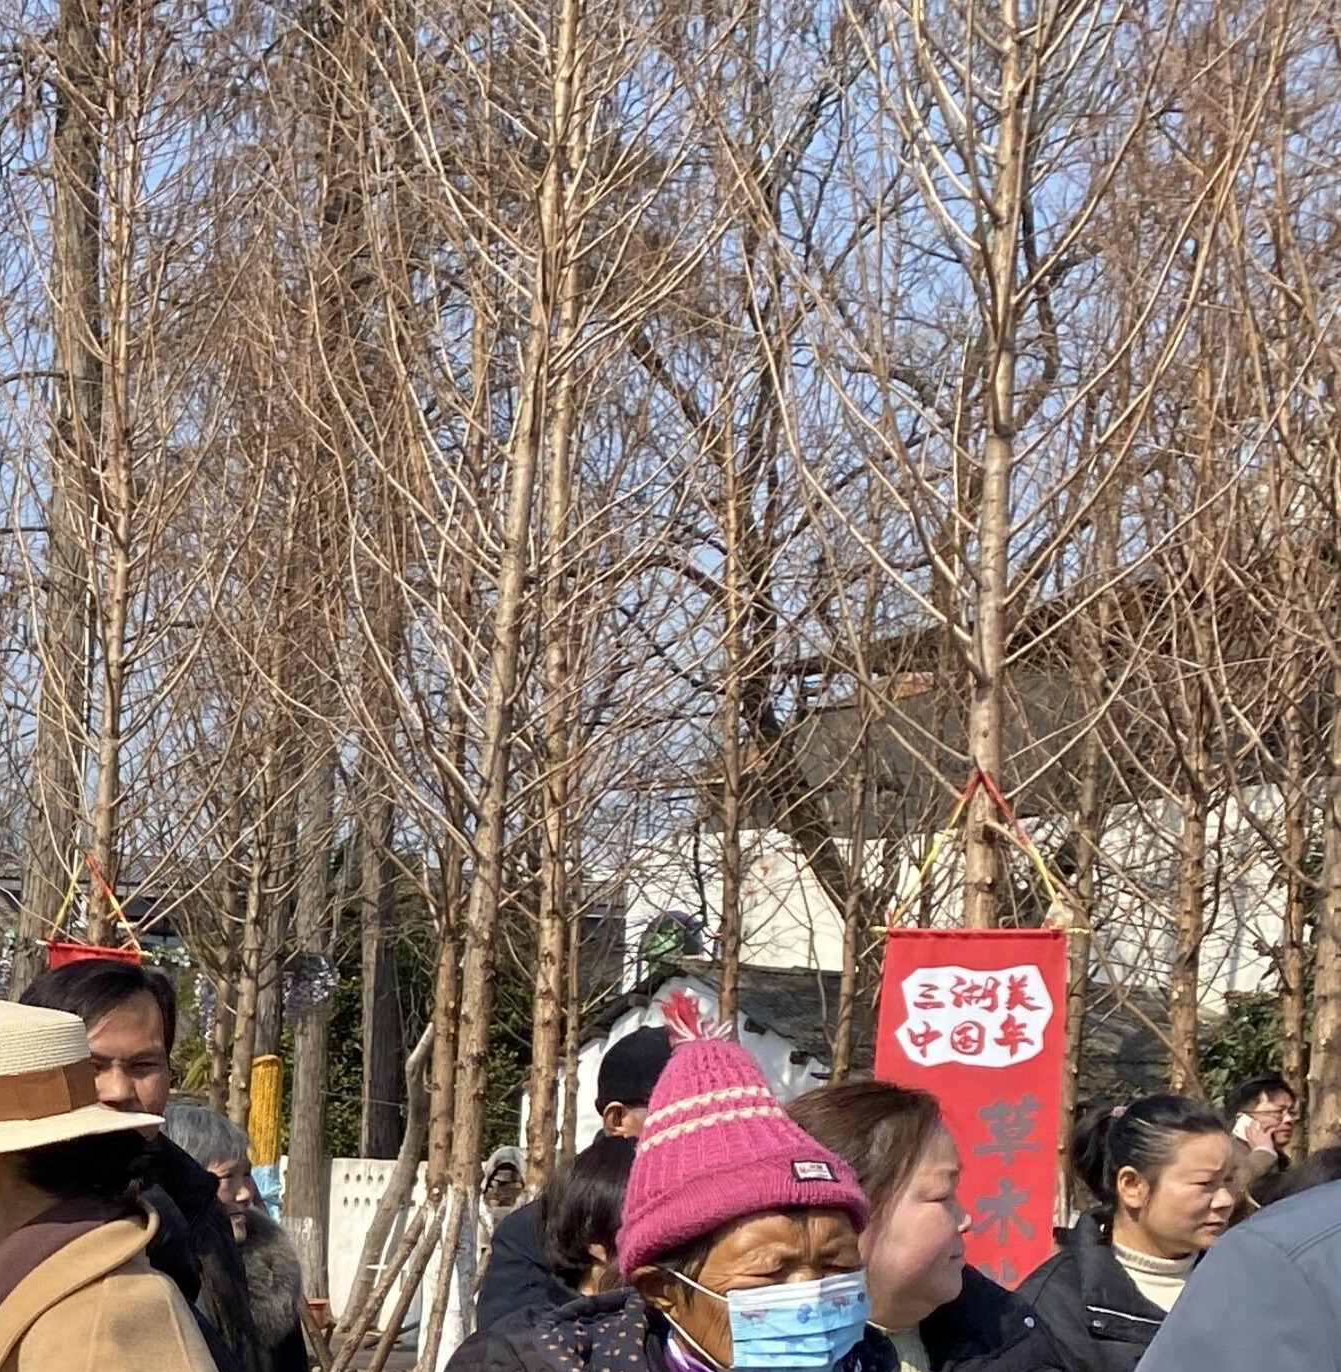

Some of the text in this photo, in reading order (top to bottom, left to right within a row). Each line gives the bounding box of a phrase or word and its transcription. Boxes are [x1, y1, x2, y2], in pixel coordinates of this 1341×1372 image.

[912, 973, 1046, 1013] 三湖美
[906, 1013, 1036, 1058] 中国年
